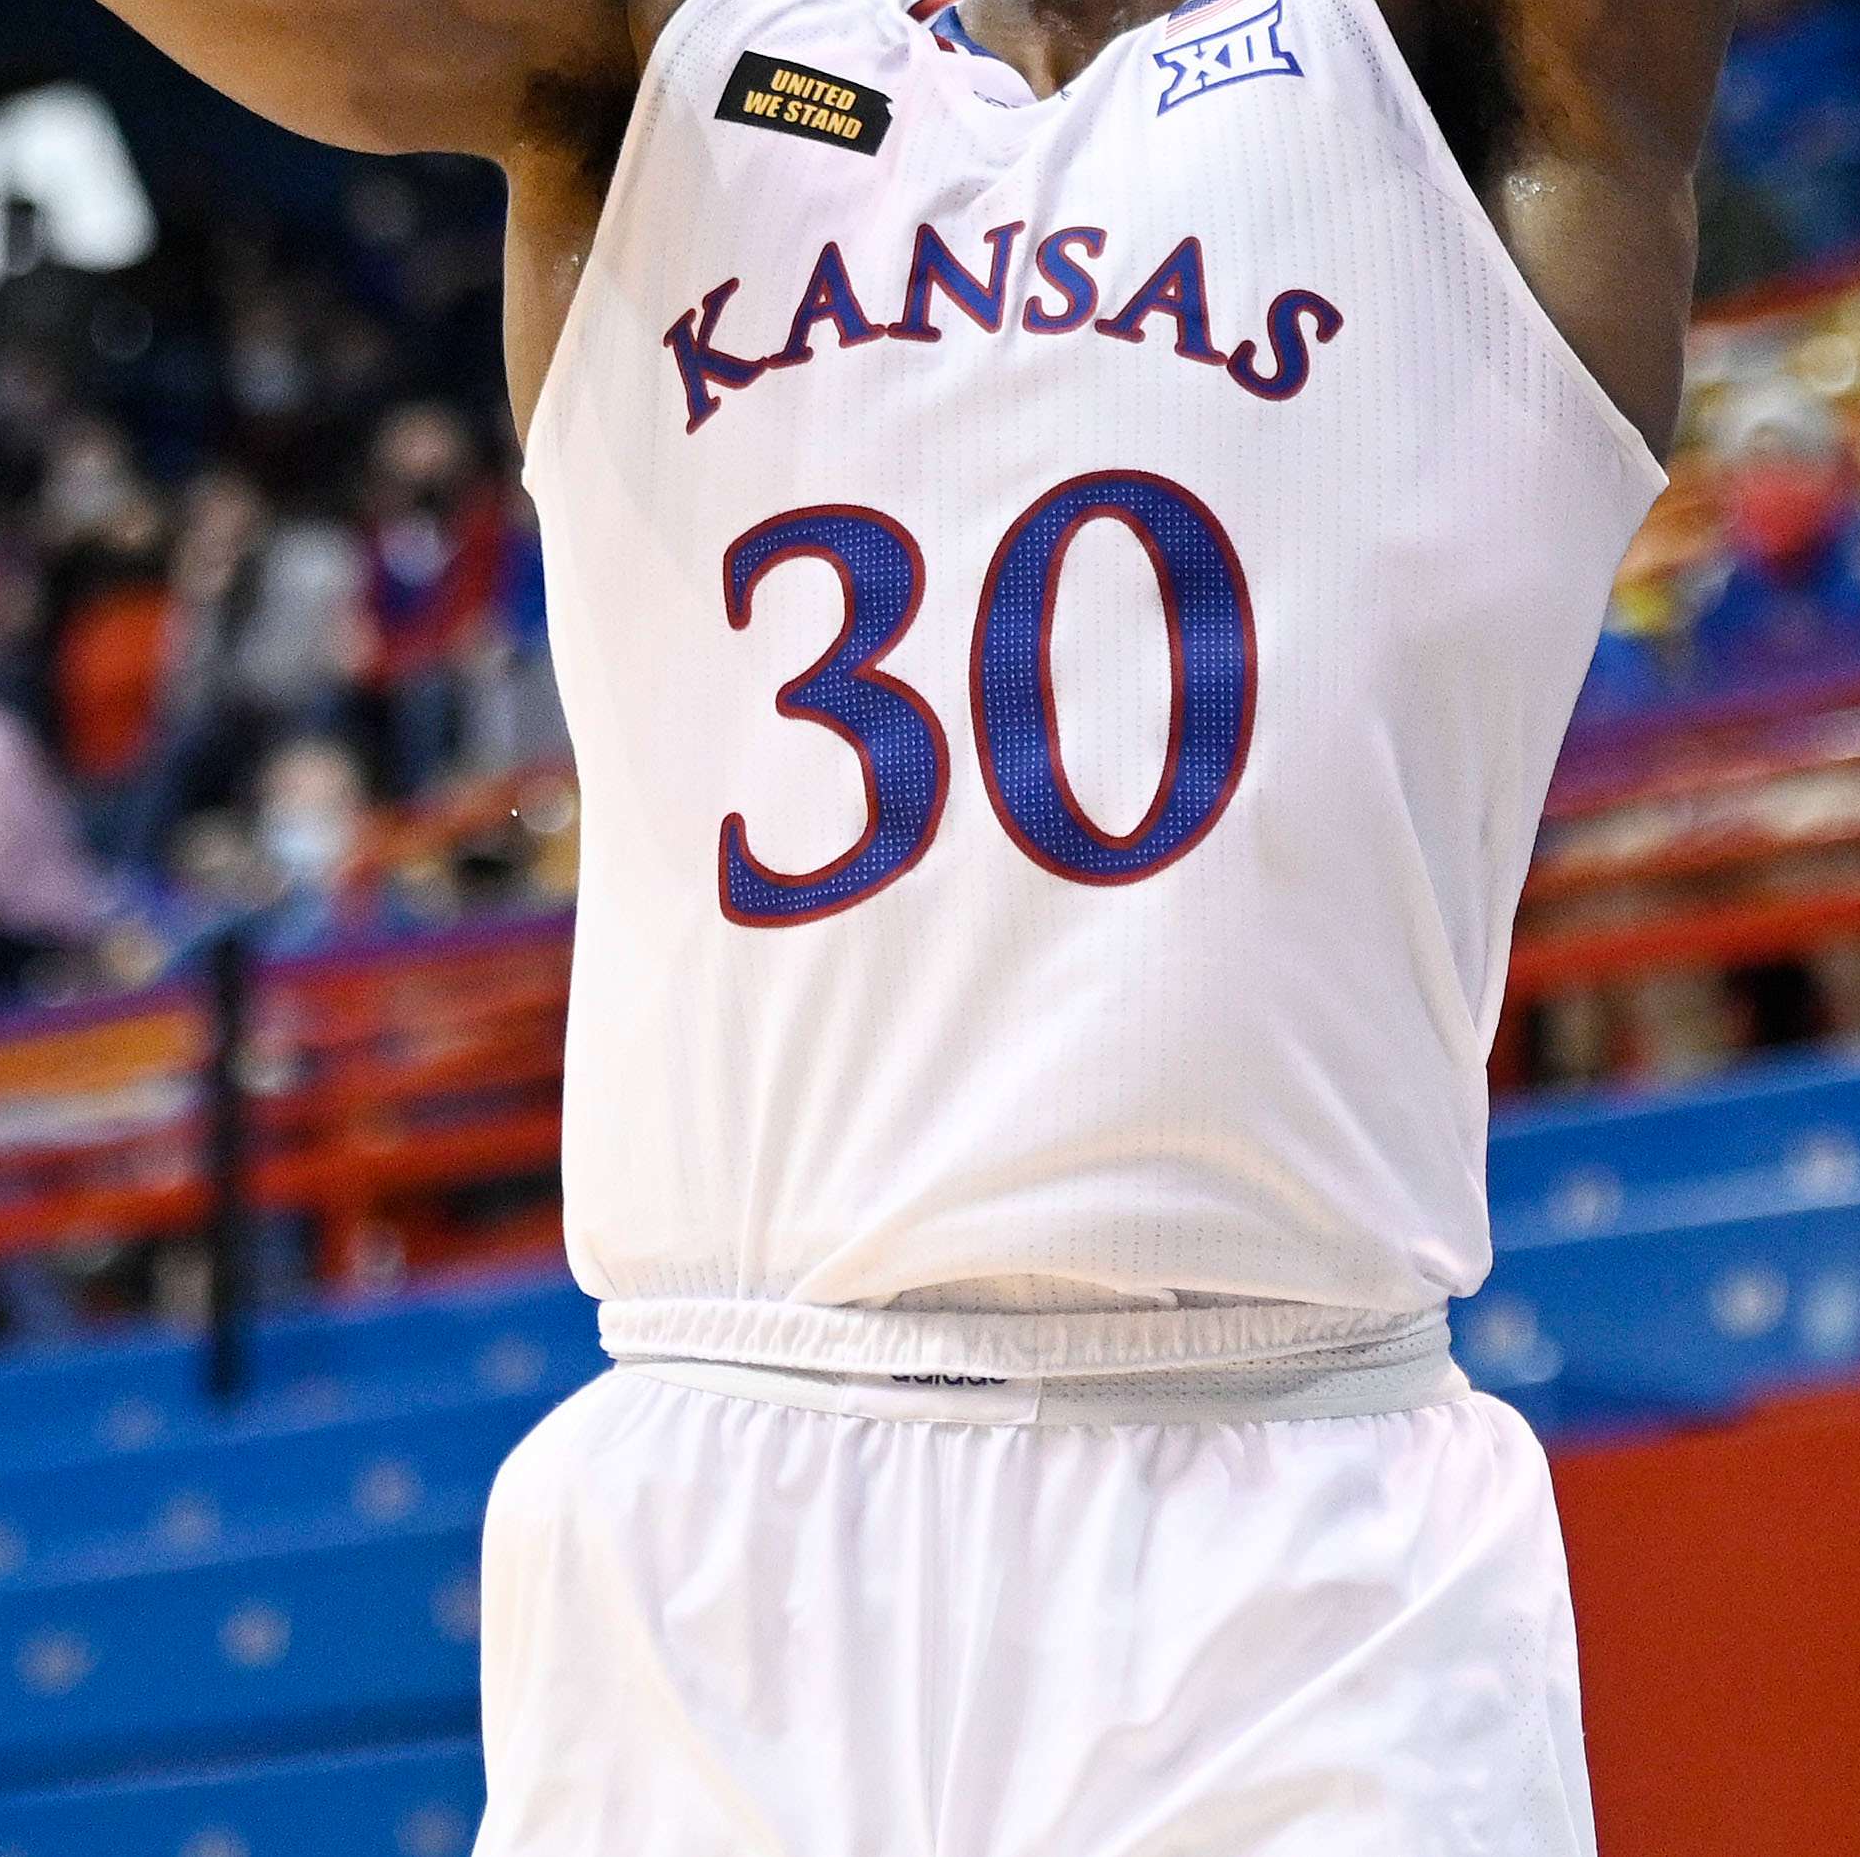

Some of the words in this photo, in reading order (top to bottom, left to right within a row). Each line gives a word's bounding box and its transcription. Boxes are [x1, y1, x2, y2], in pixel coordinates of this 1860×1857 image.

[743, 90, 784, 118] WE
[784, 100, 863, 140] STAND
[770, 69, 857, 112] UNITED
[662, 220, 1344, 436] KANSAS
[718, 469, 1259, 929] 30
